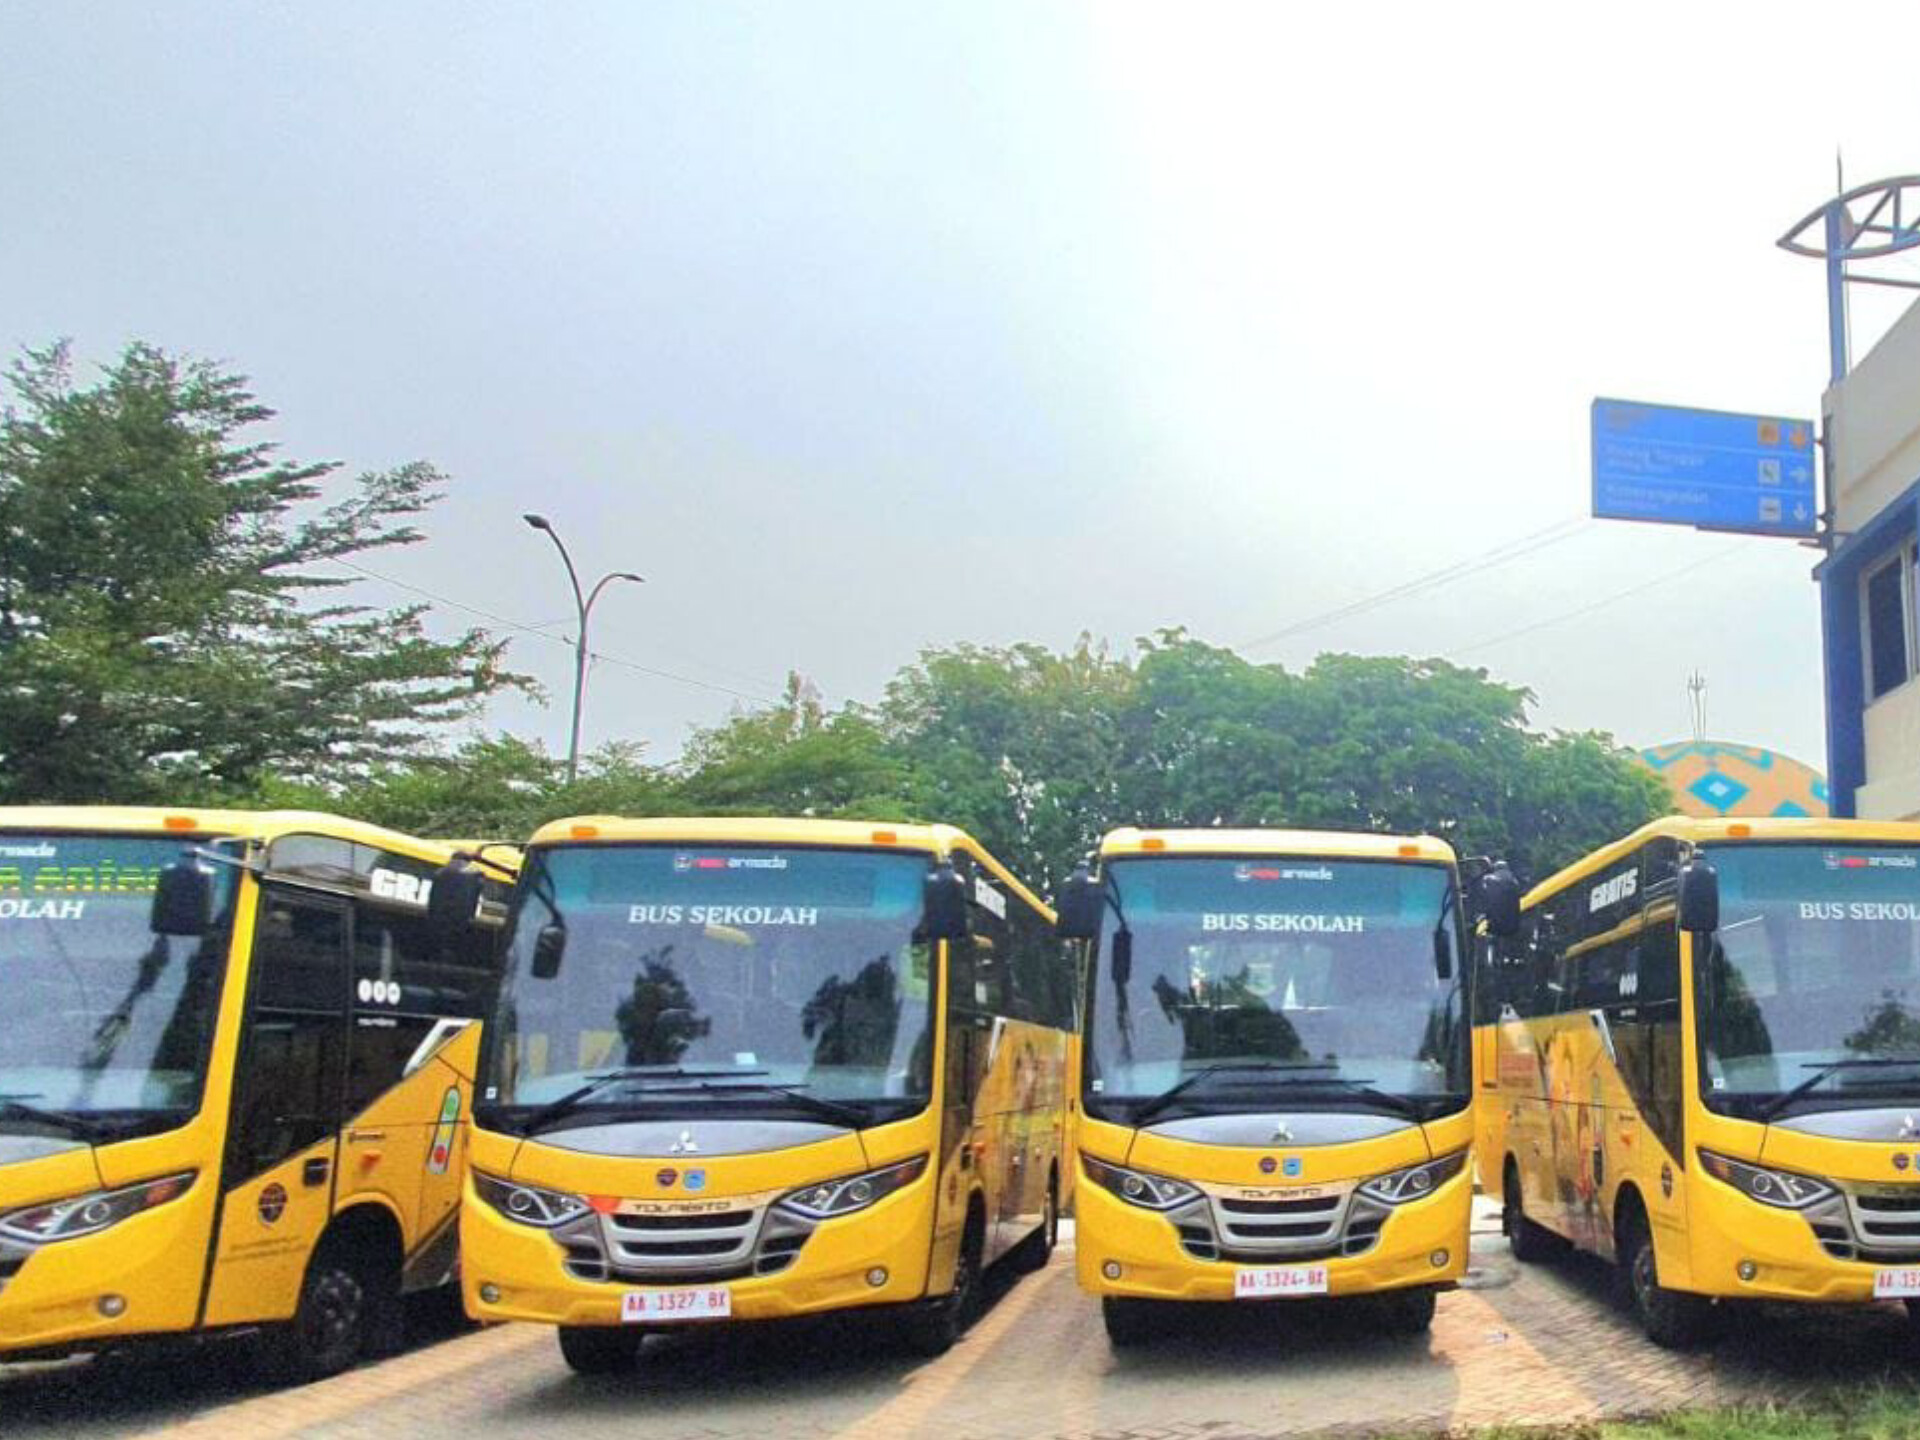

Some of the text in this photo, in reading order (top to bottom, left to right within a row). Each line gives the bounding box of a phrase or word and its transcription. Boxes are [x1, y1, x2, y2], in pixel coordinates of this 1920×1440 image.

[628, 904, 818, 925] BUS SEKOLAH
[1800, 902, 1845, 920] BUS
[1202, 913, 1364, 932] BUS SEKOLAH
[1903, 1271, 1920, 1288] 13
